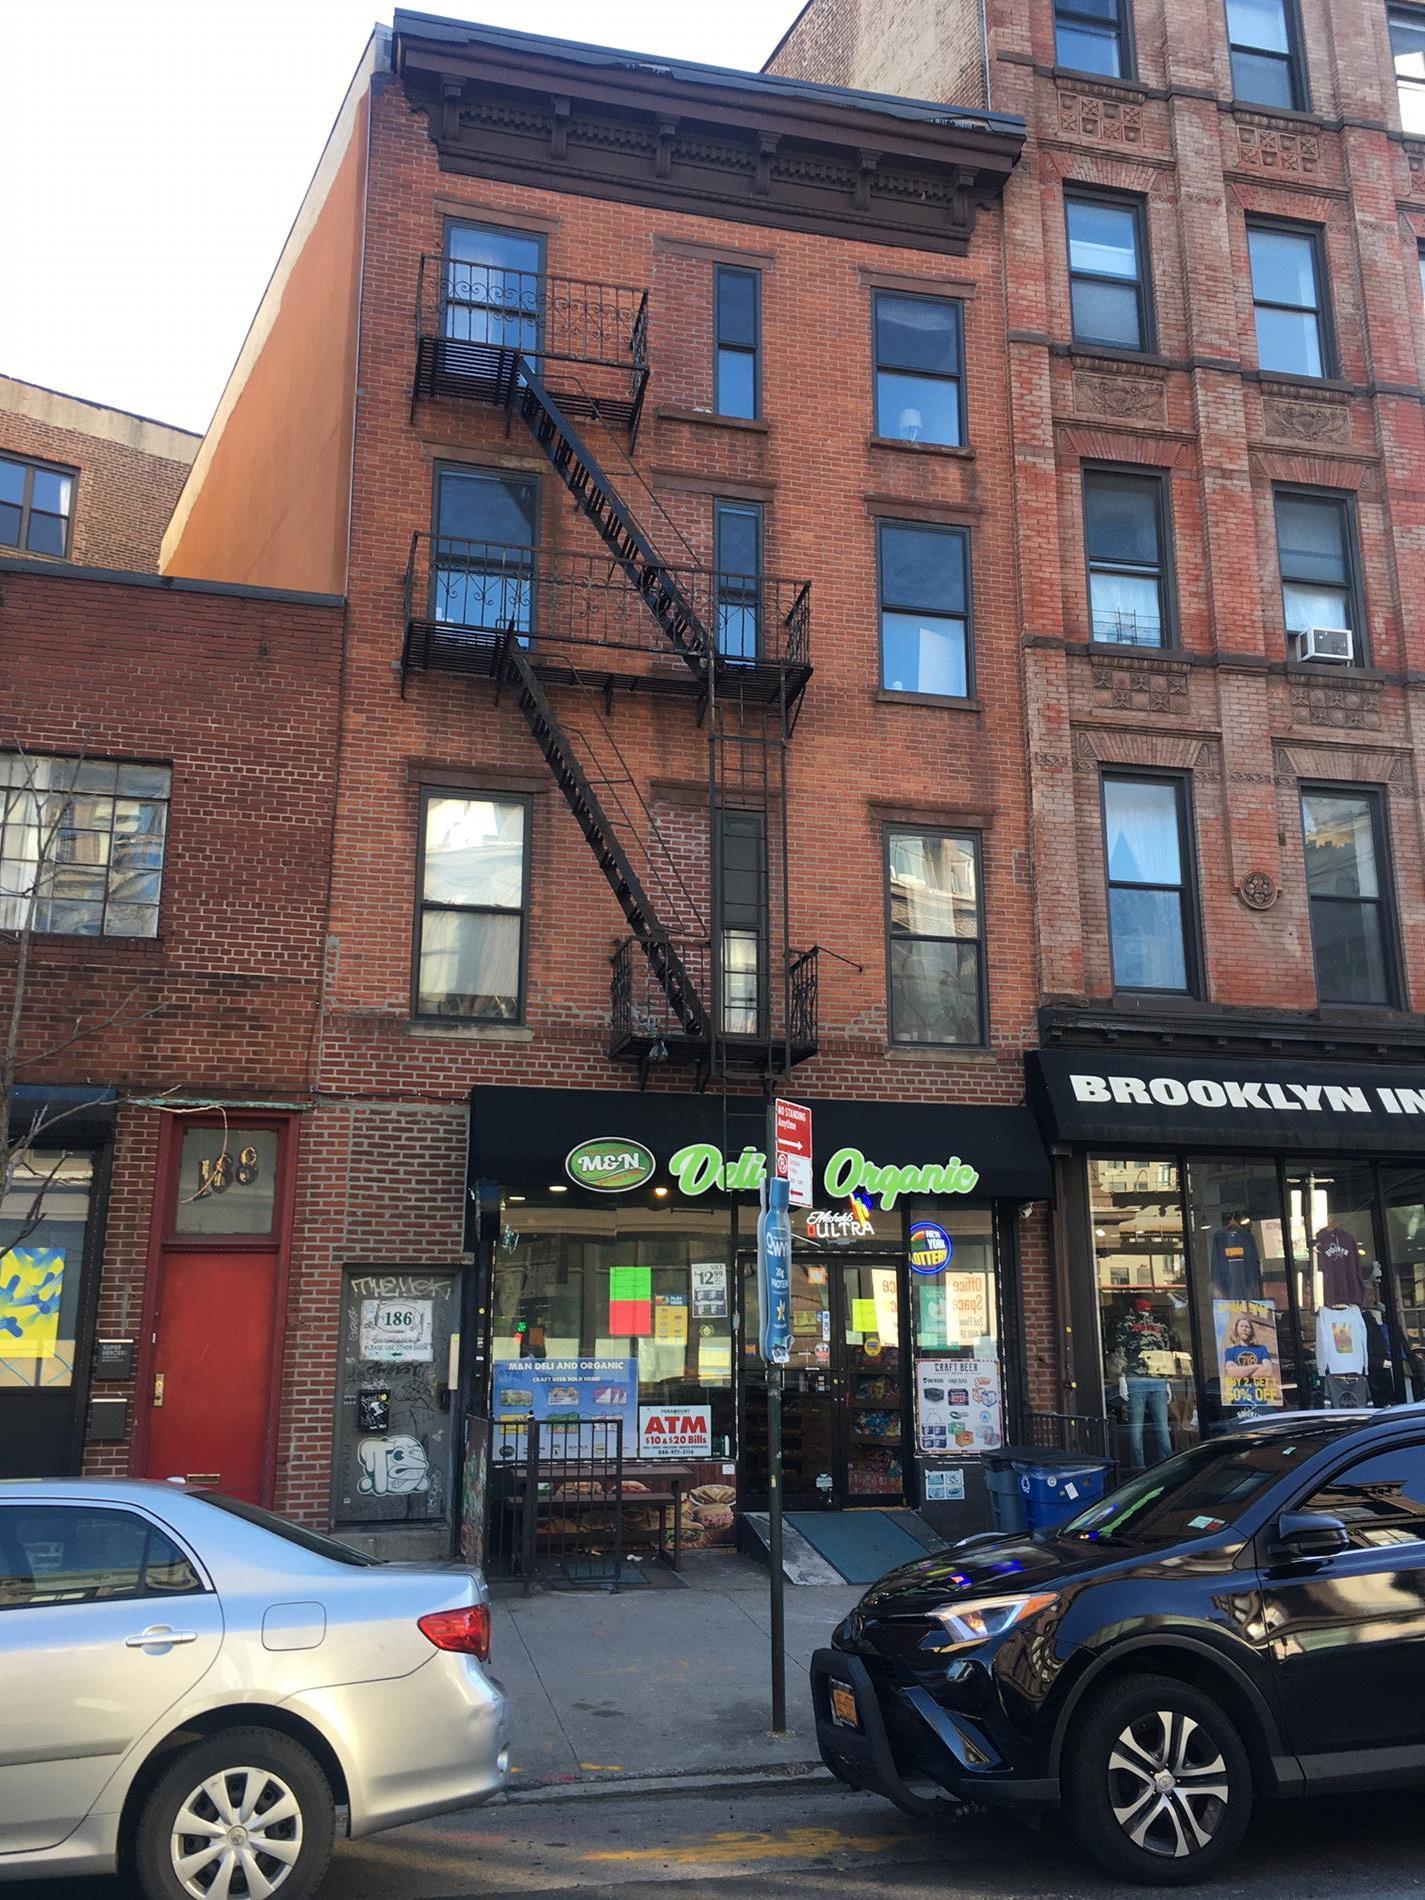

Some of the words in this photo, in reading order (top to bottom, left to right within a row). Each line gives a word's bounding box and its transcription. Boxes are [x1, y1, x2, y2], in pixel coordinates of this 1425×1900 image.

[1069, 1074, 1372, 1113] BROOKLYN
[777, 1105, 785, 1116] NO
[784, 1107, 807, 1122] STANDING
[778, 1117, 797, 1131] Anytime
[577, 1152, 642, 1172] M&N
[669, 1143, 767, 1196] Deli
[823, 1147, 980, 1211] Organic
[816, 1220, 875, 1238] ULTRA
[925, 1230, 942, 1239] NEW
[927, 1238, 946, 1250] YORK
[385, 1311, 412, 1326] 186
[508, 1362, 532, 1371] M&N
[534, 1361, 555, 1370] DELI
[556, 1361, 579, 1370] AND
[580, 1361, 624, 1370] ORGANIC
[934, 1363, 958, 1372] CRAFT
[960, 1363, 979, 1372] BEER
[1254, 1377, 1271, 1387] GET
[1225, 1388, 1252, 1402] 50%
[1255, 1388, 1278, 1401] OFF
[644, 1416, 707, 1434] ATM
[646, 1436, 661, 1444] $10
[669, 1436, 686, 1444] $20
[688, 1435, 707, 1444] Bills
